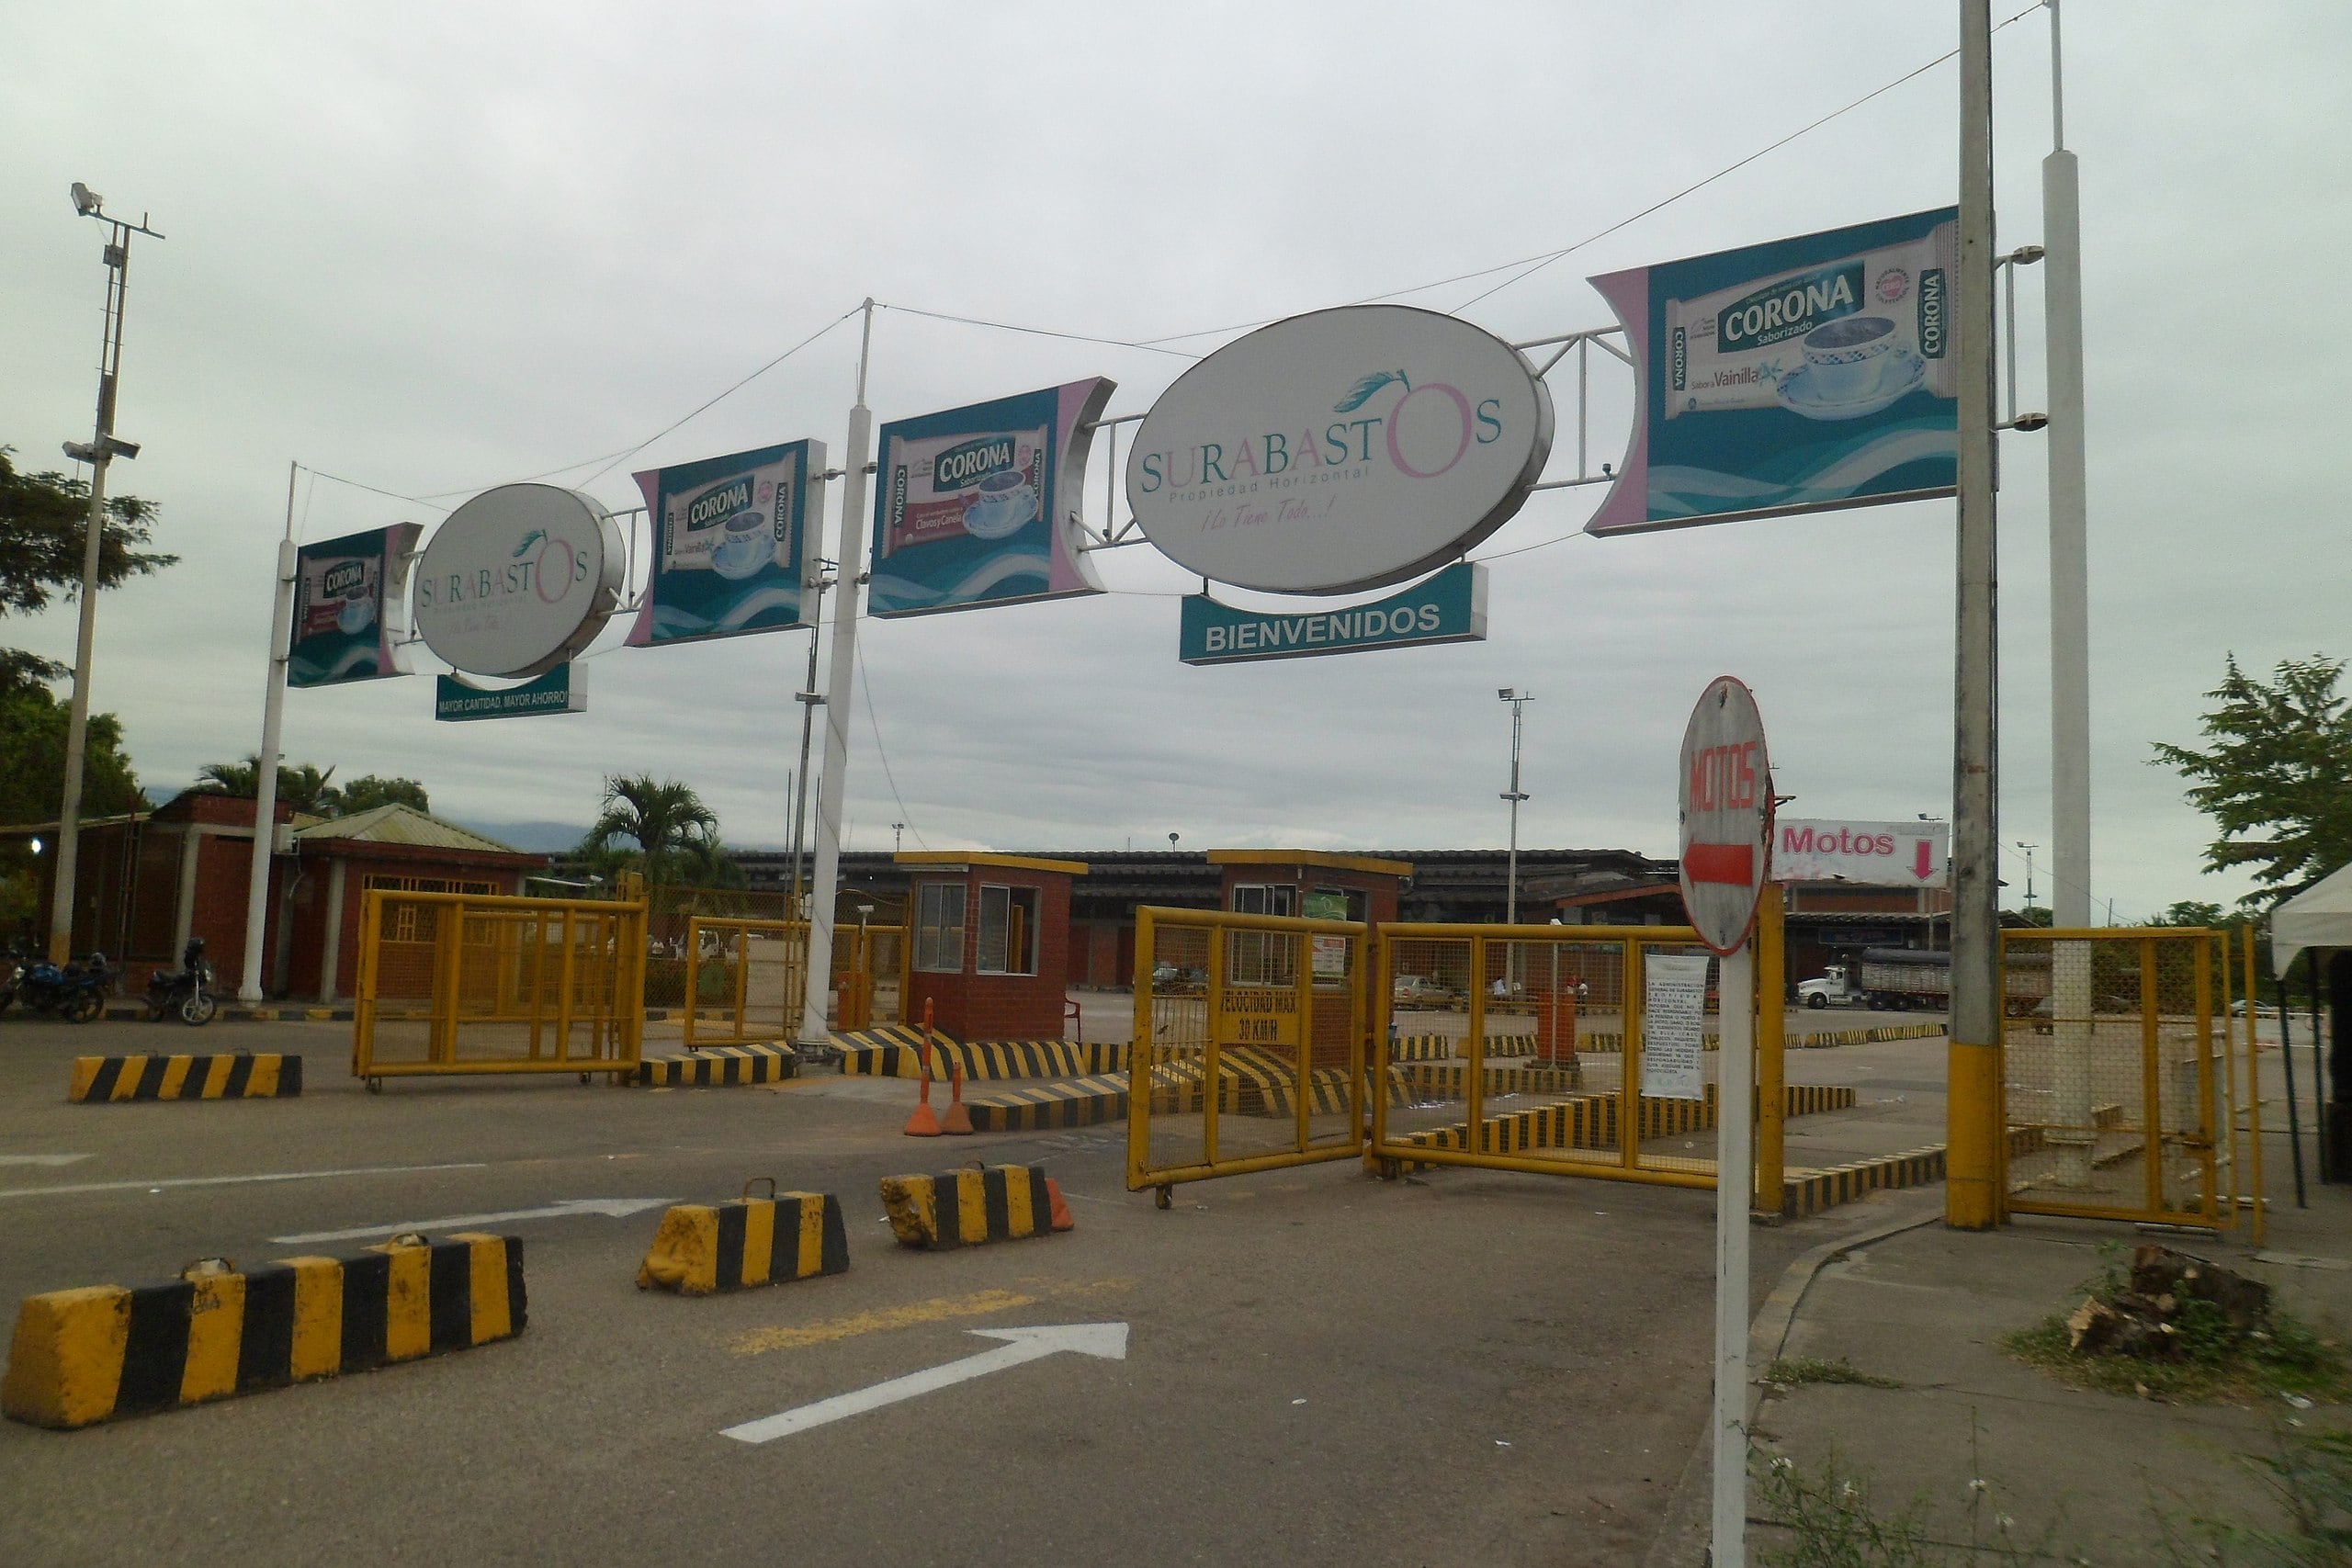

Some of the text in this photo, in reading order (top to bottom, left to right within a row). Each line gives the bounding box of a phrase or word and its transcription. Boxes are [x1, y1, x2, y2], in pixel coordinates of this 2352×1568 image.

[1725, 274, 1854, 343] CORONA
[1923, 275, 1940, 355] CORONA
[1757, 321, 1814, 346] Saborizado
[1675, 331, 1684, 388] CORONA
[1714, 367, 1758, 387] Vainilla
[1141, 382, 1502, 493] SURABASTOS
[939, 442, 1011, 483] CORONA
[1169, 466, 1369, 503] Propiedad Horizontal
[691, 483, 749, 525] CORONA
[775, 486, 786, 538] CORONA
[894, 468, 906, 525] CORONA
[326, 564, 363, 592] CORONA
[422, 538, 588, 608] SURABASTOS
[1205, 604, 1441, 652] BIENVENIDOS
[438, 700, 464, 713] MAYOR
[504, 694, 530, 708] MAYOR
[532, 690, 568, 705] AHORRO!
[1690, 741, 1757, 813] MOTOS
[1782, 826, 1895, 856] Motos
[1238, 1018, 1250, 1040] 30
